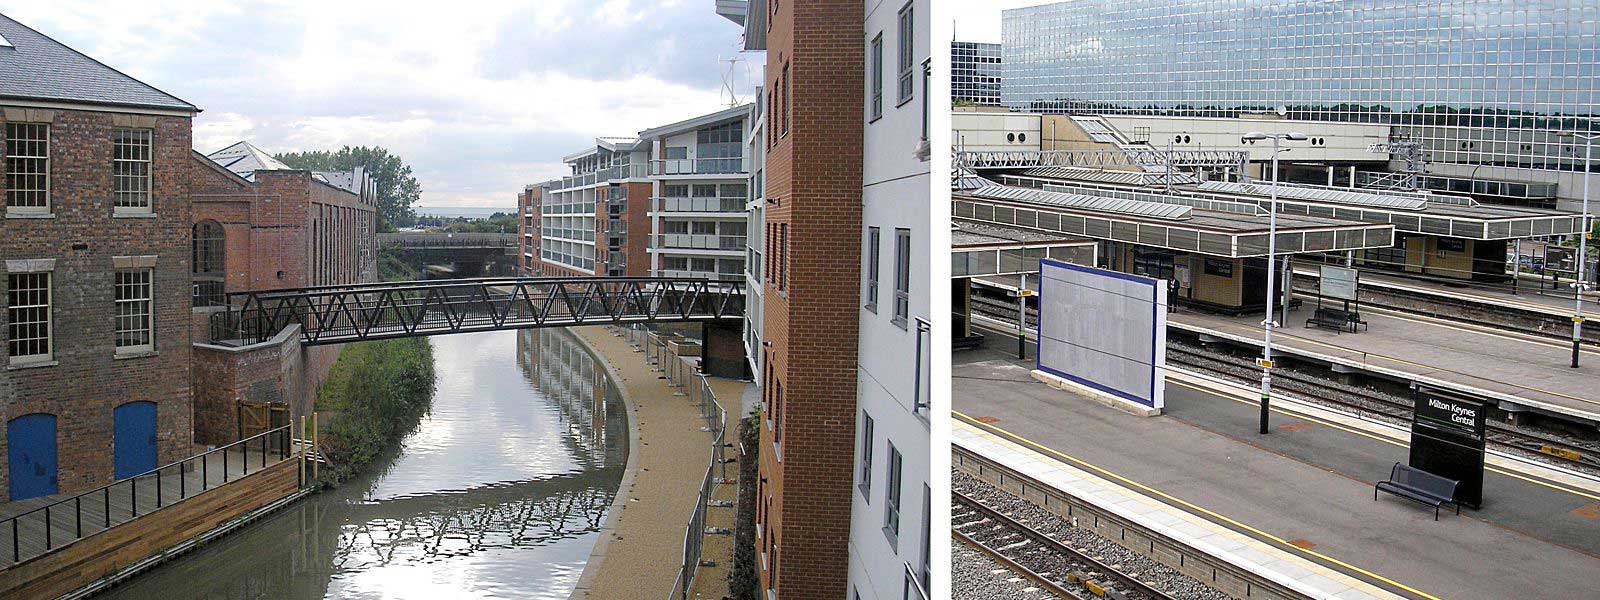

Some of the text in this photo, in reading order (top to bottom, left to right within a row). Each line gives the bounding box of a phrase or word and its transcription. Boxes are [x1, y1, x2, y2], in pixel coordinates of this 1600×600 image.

[1429, 398, 1476, 417] Milton Keynes
[1451, 413, 1475, 427] Central
